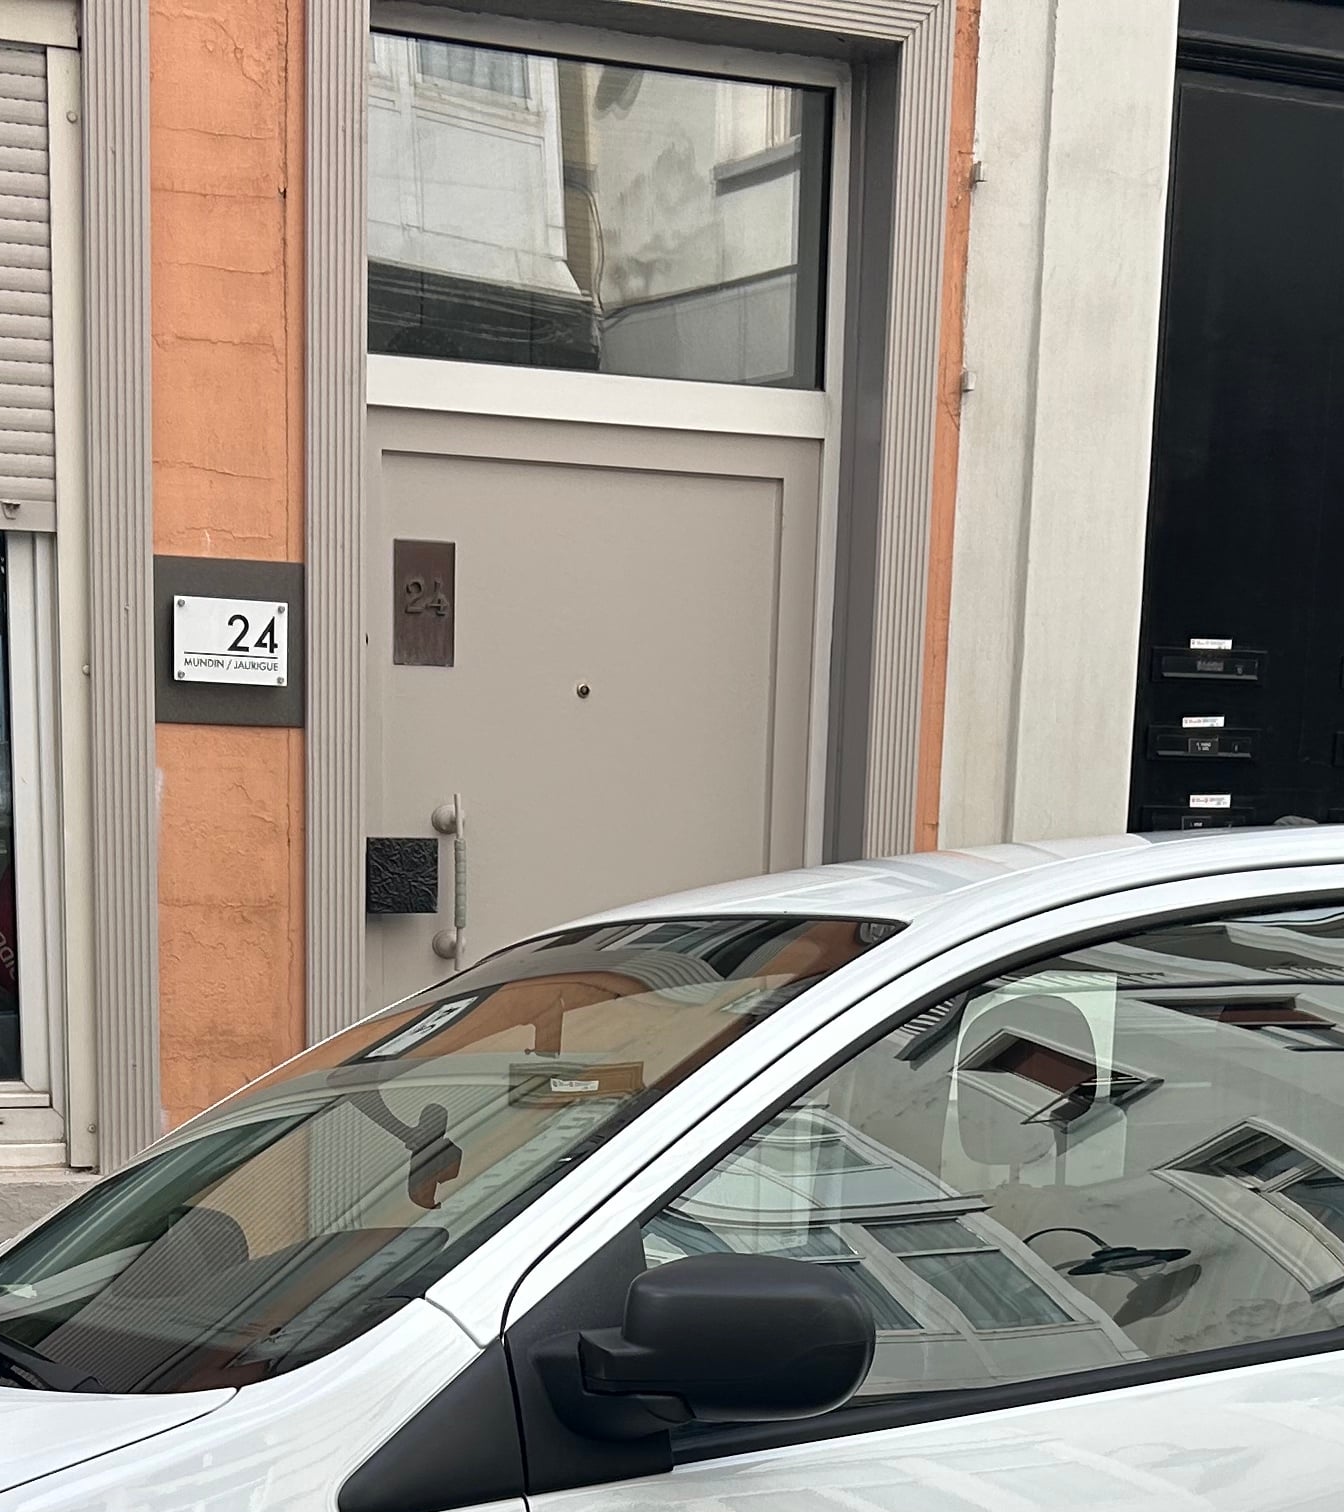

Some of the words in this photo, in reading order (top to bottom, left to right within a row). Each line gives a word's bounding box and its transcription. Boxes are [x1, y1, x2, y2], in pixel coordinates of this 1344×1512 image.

[405, 576, 448, 617] 24
[227, 614, 278, 653] 24
[183, 657, 225, 669] MUNDIN
